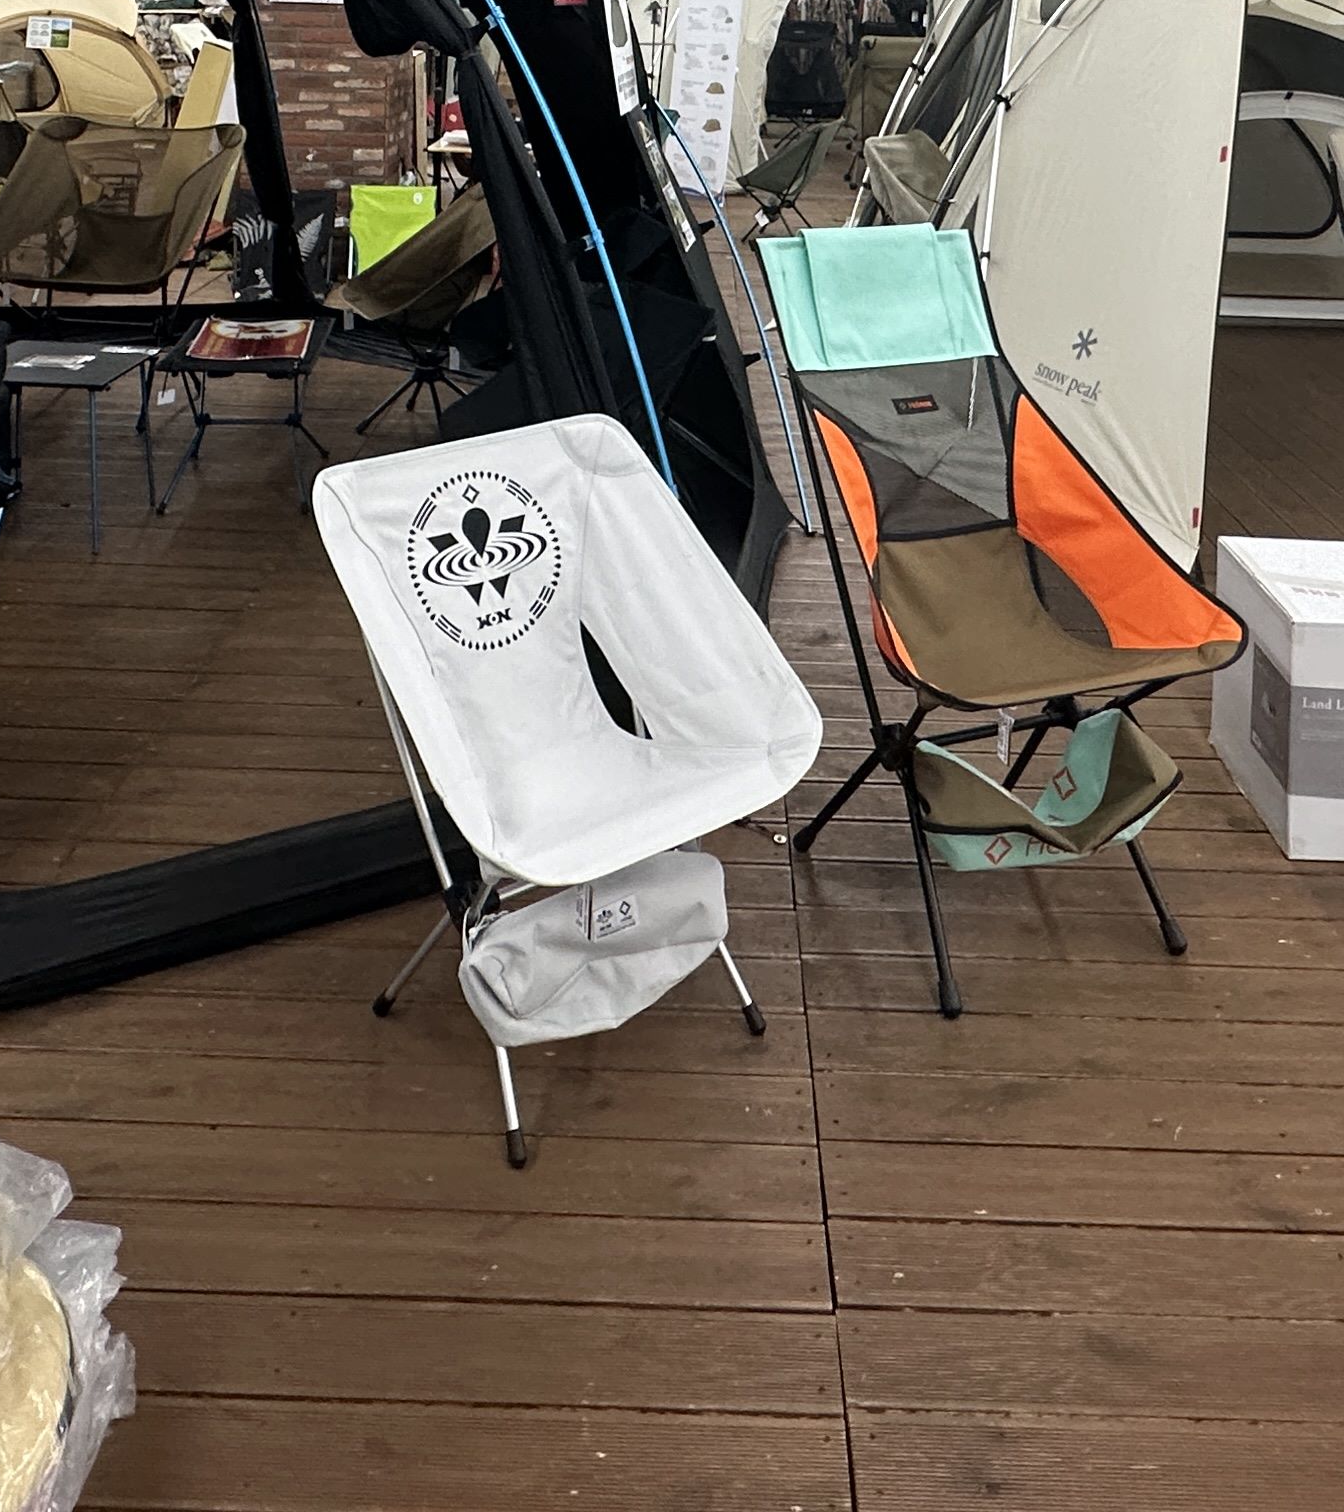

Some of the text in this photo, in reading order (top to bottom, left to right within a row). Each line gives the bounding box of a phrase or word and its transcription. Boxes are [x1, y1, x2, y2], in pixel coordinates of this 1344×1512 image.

[1034, 362, 1070, 386] snow
[1065, 377, 1101, 401] peak
[1301, 697, 1332, 711] Land
